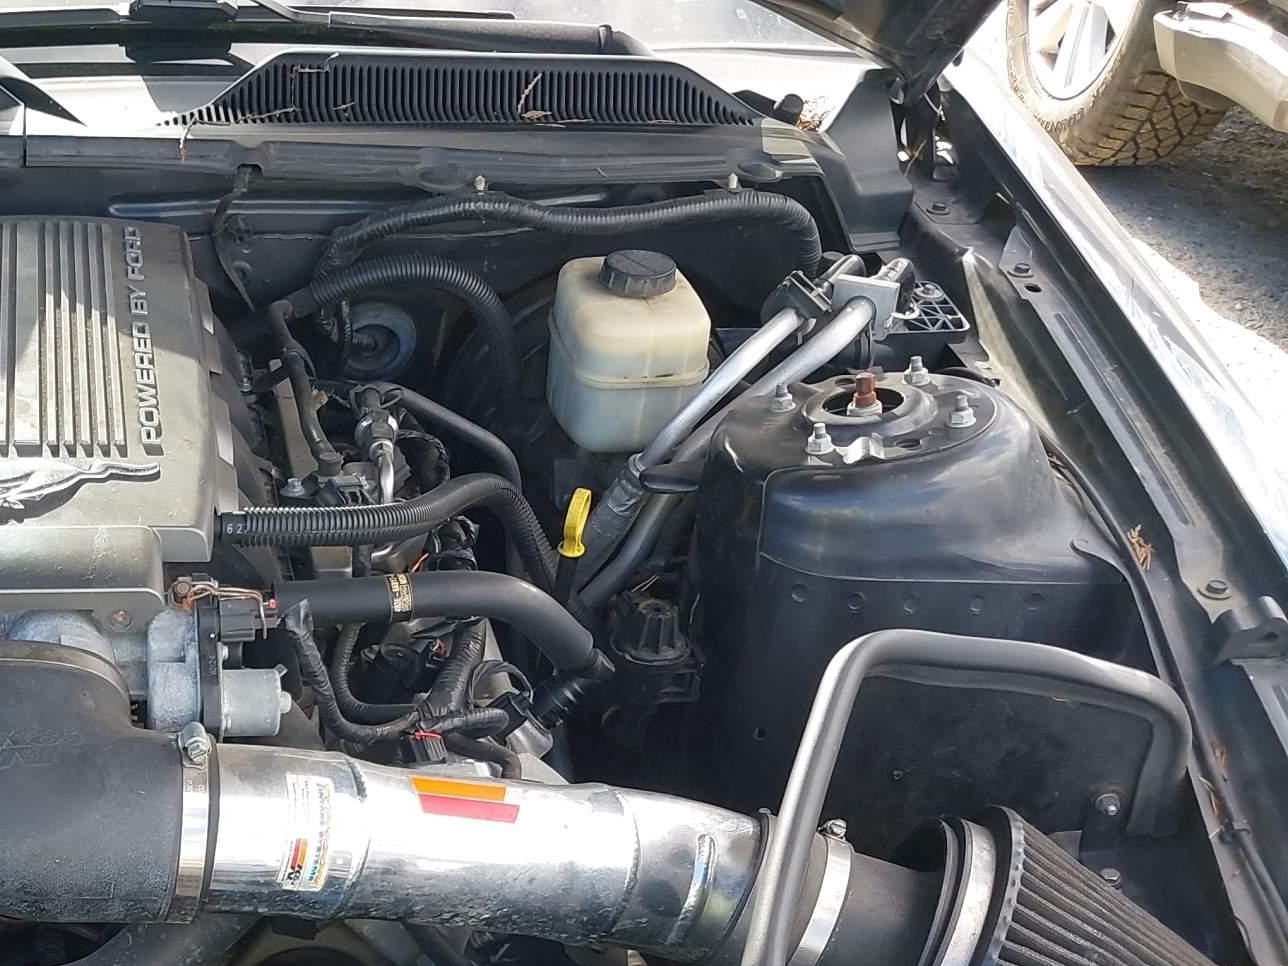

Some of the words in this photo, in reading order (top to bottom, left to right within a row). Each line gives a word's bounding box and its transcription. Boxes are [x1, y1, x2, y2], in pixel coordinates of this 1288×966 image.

[124, 224, 144, 281] FORD
[128, 284, 148, 314] BY
[132, 322, 162, 445] POWERED
